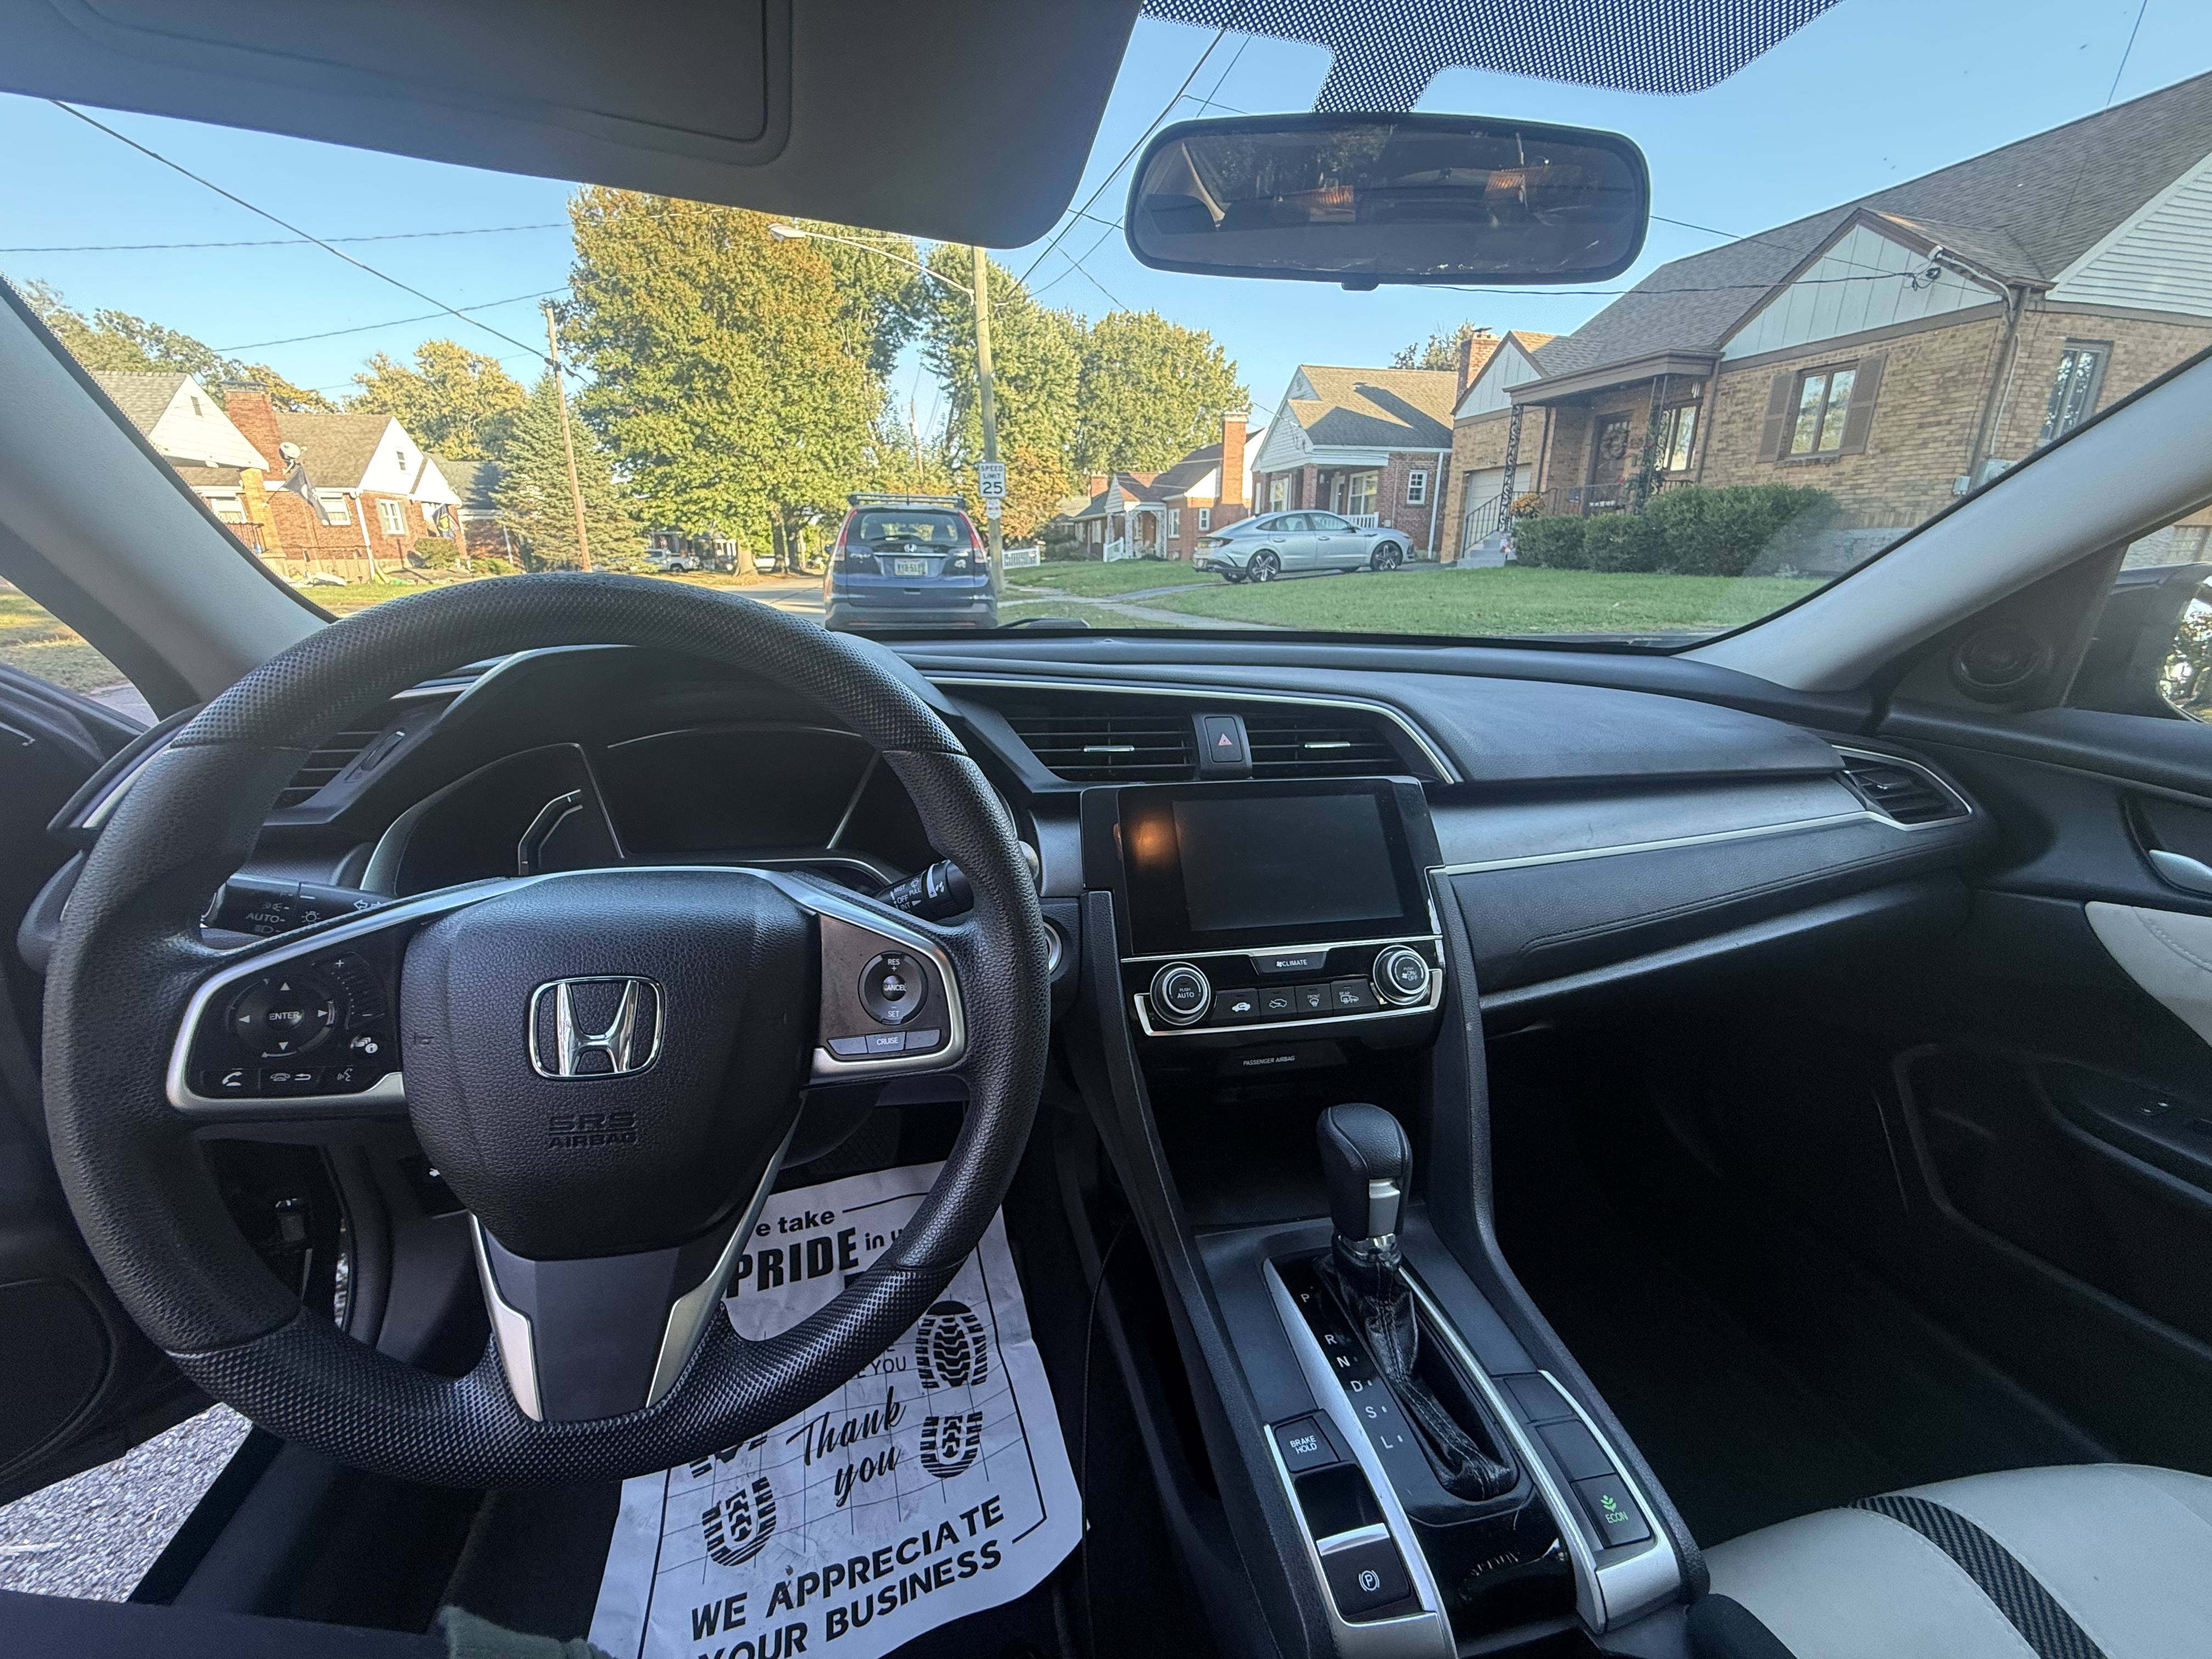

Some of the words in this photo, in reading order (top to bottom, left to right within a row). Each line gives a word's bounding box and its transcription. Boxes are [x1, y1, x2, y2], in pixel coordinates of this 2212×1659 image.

[983, 482, 1003, 494] 25
[894, 884, 906, 893] MIST
[896, 894, 908, 904] OFF
[900, 902, 911, 910] INT
[246, 913, 280, 923] AUTO
[269, 1011, 300, 1020] ENTER
[877, 1037, 899, 1045] CRUISE
[549, 1112, 636, 1132] SRS
[549, 1132, 639, 1150] AIRBAG
[778, 1210, 835, 1234] take
[726, 1227, 859, 1299] PRIDE
[865, 1232, 885, 1251] in
[1300, 1293, 1310, 1302] P
[1324, 1334, 1338, 1345] R
[871, 1356, 906, 1375] YOU
[1336, 1356, 1350, 1368] N
[1350, 1380, 1363, 1392] D
[1365, 1406, 1378, 1419] S
[786, 1386, 907, 1466] Thank
[1290, 1435, 1316, 1448] BRAKE
[1380, 1436, 1393, 1449] L
[1295, 1443, 1317, 1454] HOLD
[834, 1446, 902, 1508] you
[1605, 1511, 1629, 1523] ECON
[692, 1592, 748, 1641] WE
[765, 1494, 1005, 1618] APPRECIATE
[826, 1539, 1002, 1642] BUSINESS
